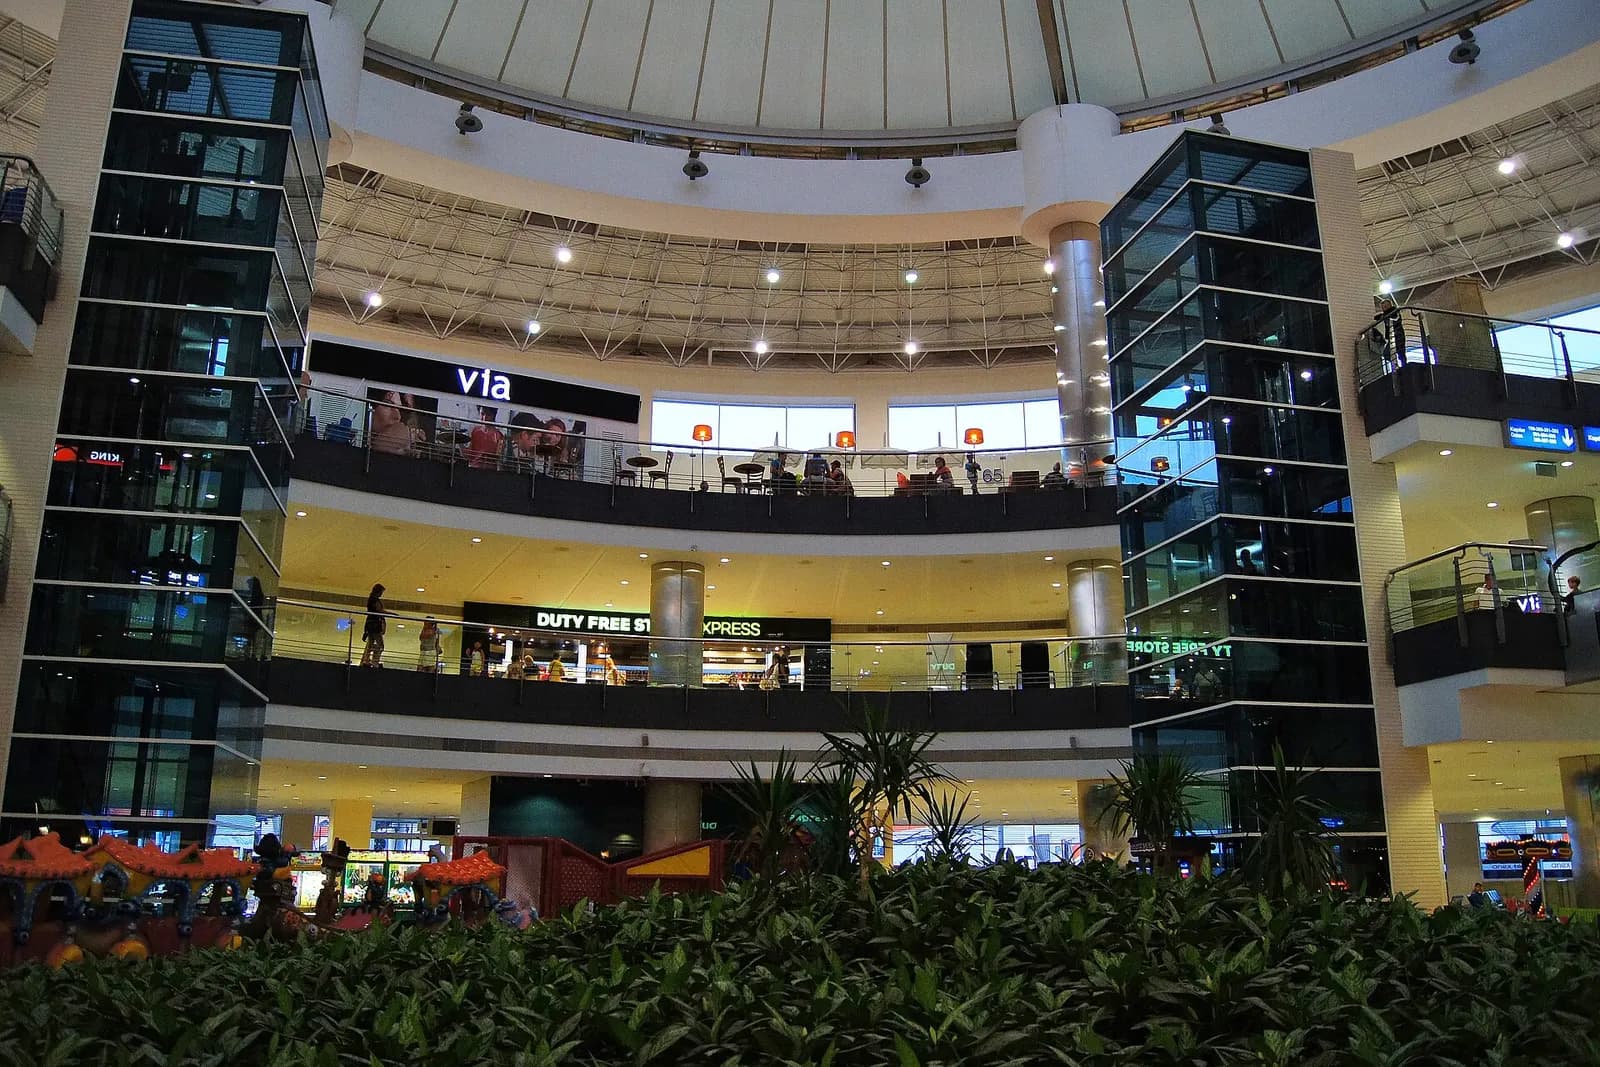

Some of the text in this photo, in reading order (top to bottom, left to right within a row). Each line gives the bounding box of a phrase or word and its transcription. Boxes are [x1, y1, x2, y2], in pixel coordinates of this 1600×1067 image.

[457, 368, 511, 401] via
[983, 468, 1003, 483] 65
[536, 612, 584, 629] DUTY
[587, 615, 631, 632] FREE
